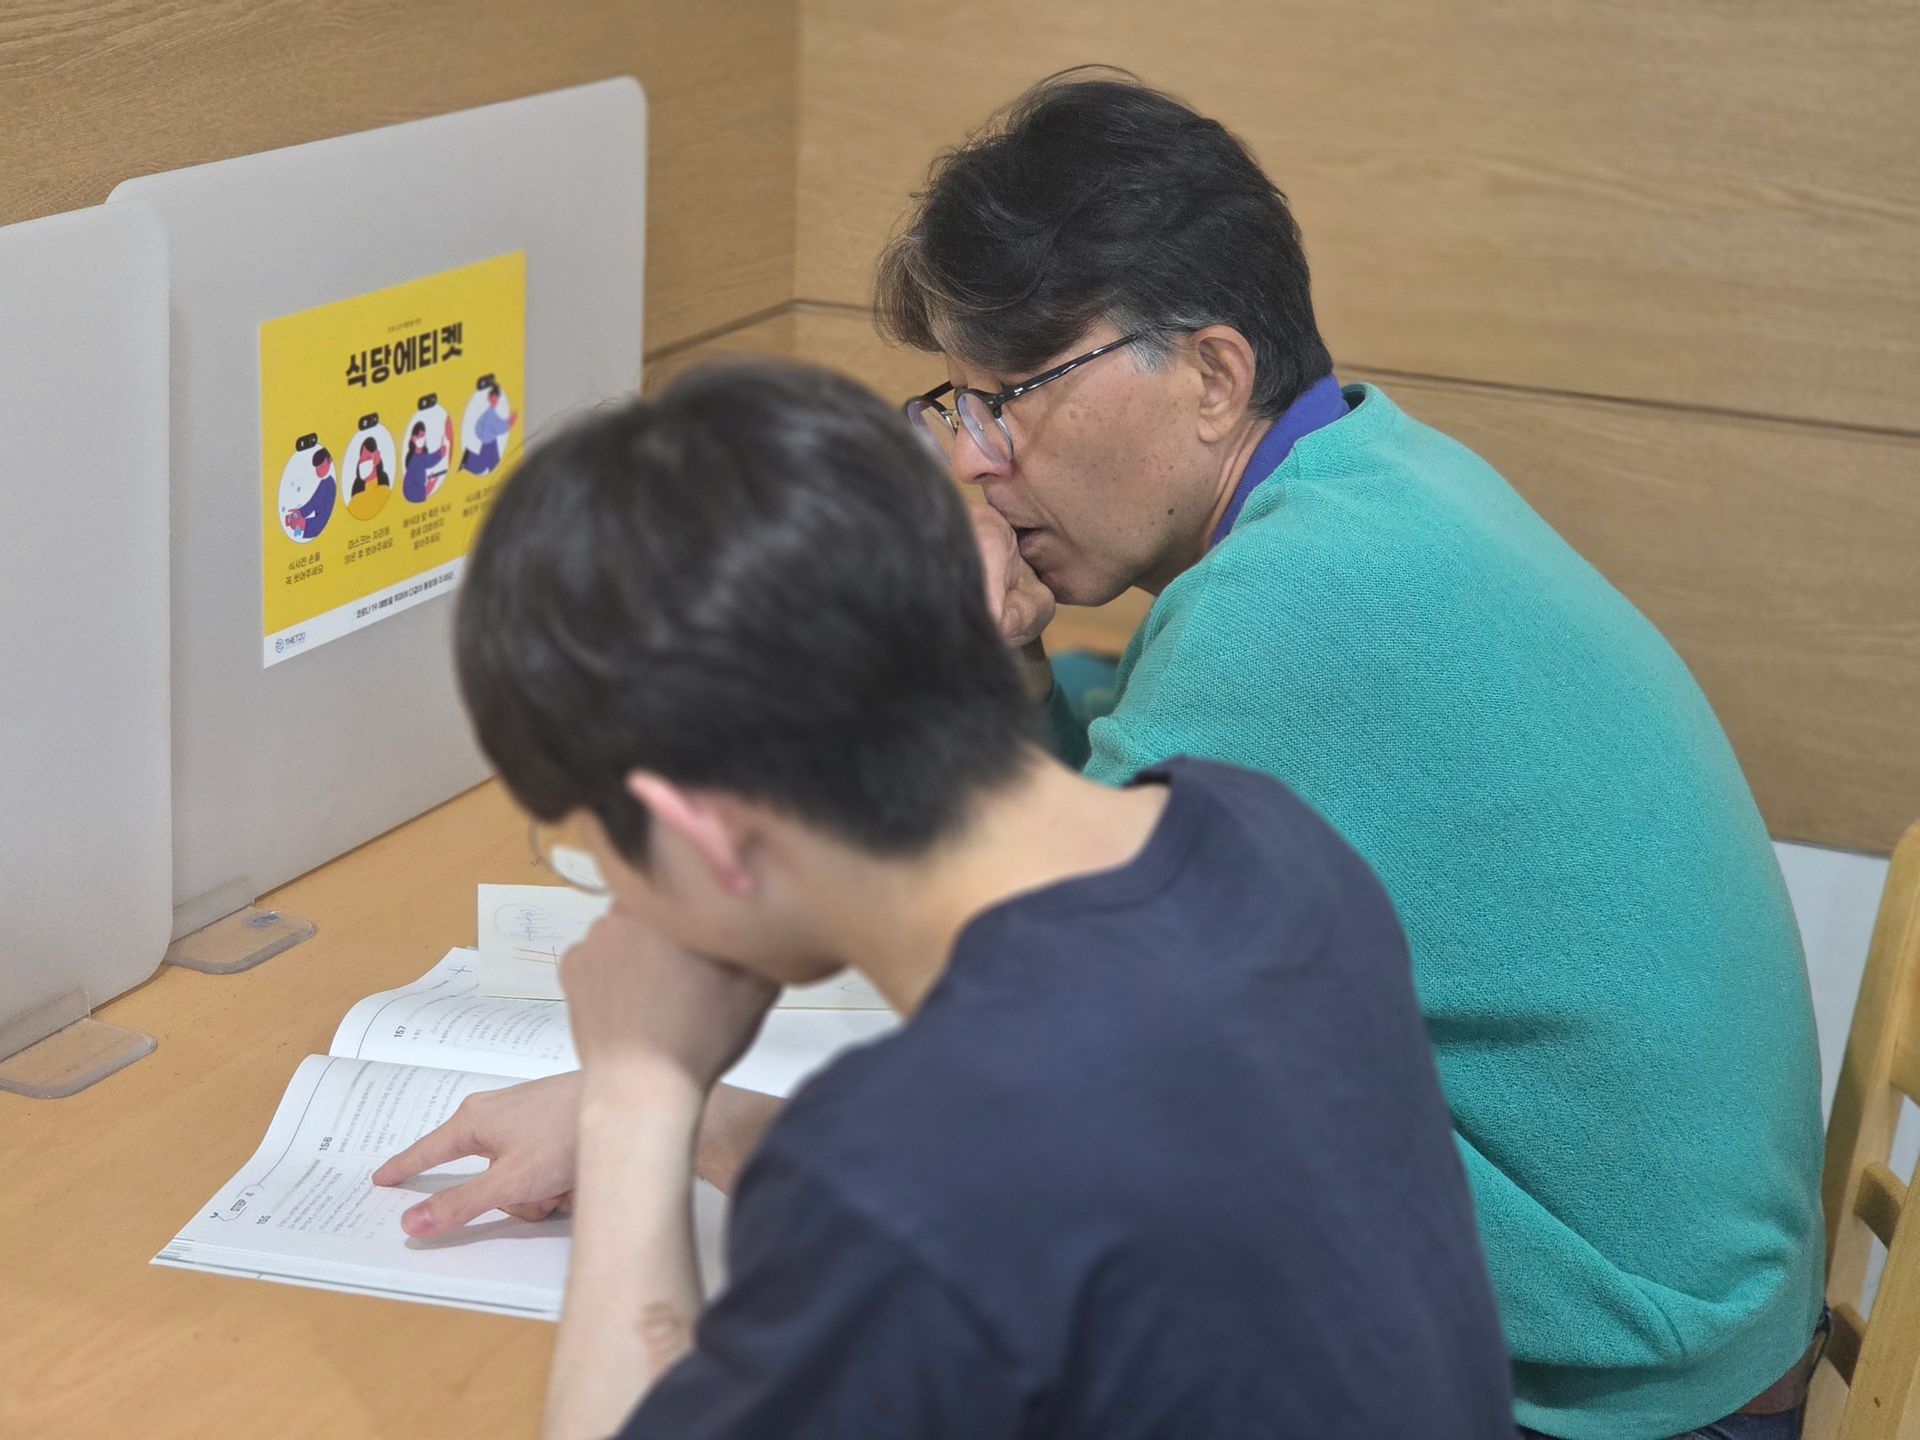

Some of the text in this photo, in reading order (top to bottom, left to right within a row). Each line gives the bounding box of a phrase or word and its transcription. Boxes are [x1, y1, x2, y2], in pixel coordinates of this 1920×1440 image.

[345, 321, 462, 388] 식당에티켓
[394, 1025, 406, 1038] 157
[319, 1136, 332, 1151] 156
